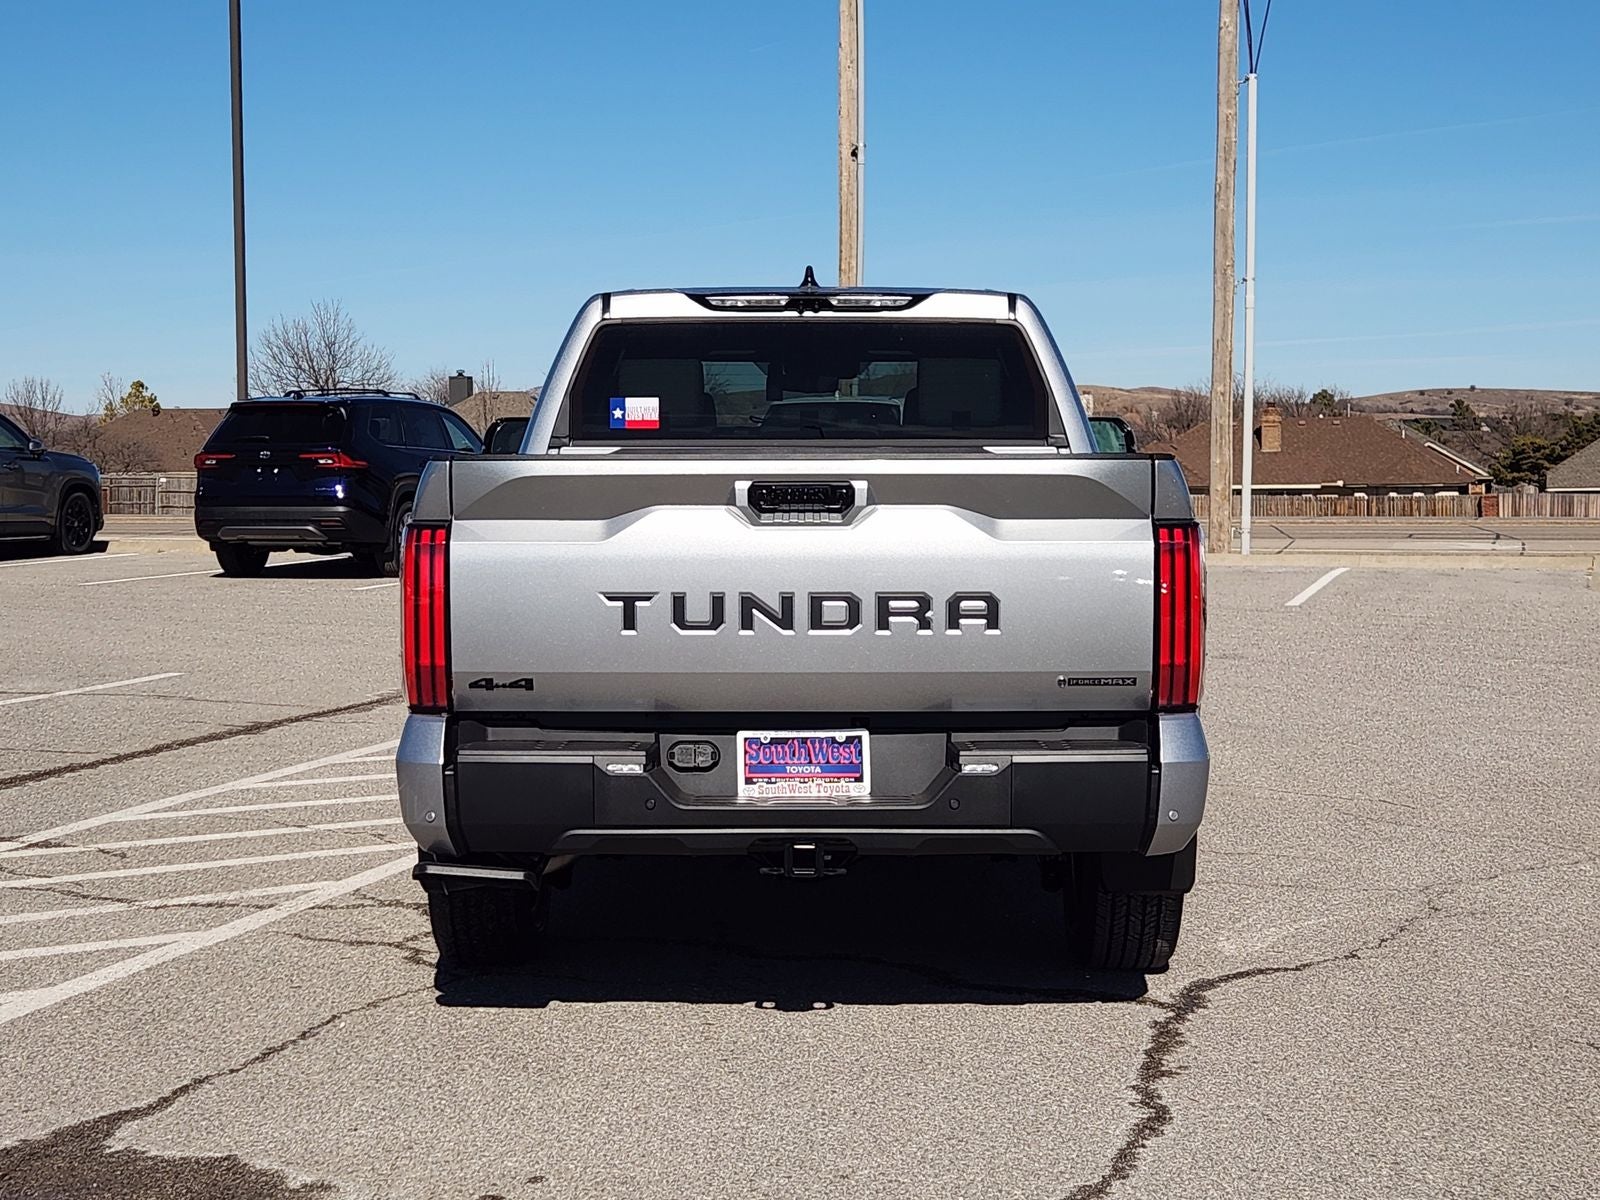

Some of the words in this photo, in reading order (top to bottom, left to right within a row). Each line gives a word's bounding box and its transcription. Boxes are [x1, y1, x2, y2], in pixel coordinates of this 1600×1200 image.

[597, 591, 1002, 636] TUNDRA
[785, 765, 822, 774] TOYOTA
[757, 783, 813, 796] SouthWest
[815, 783, 851, 796] Toyota
